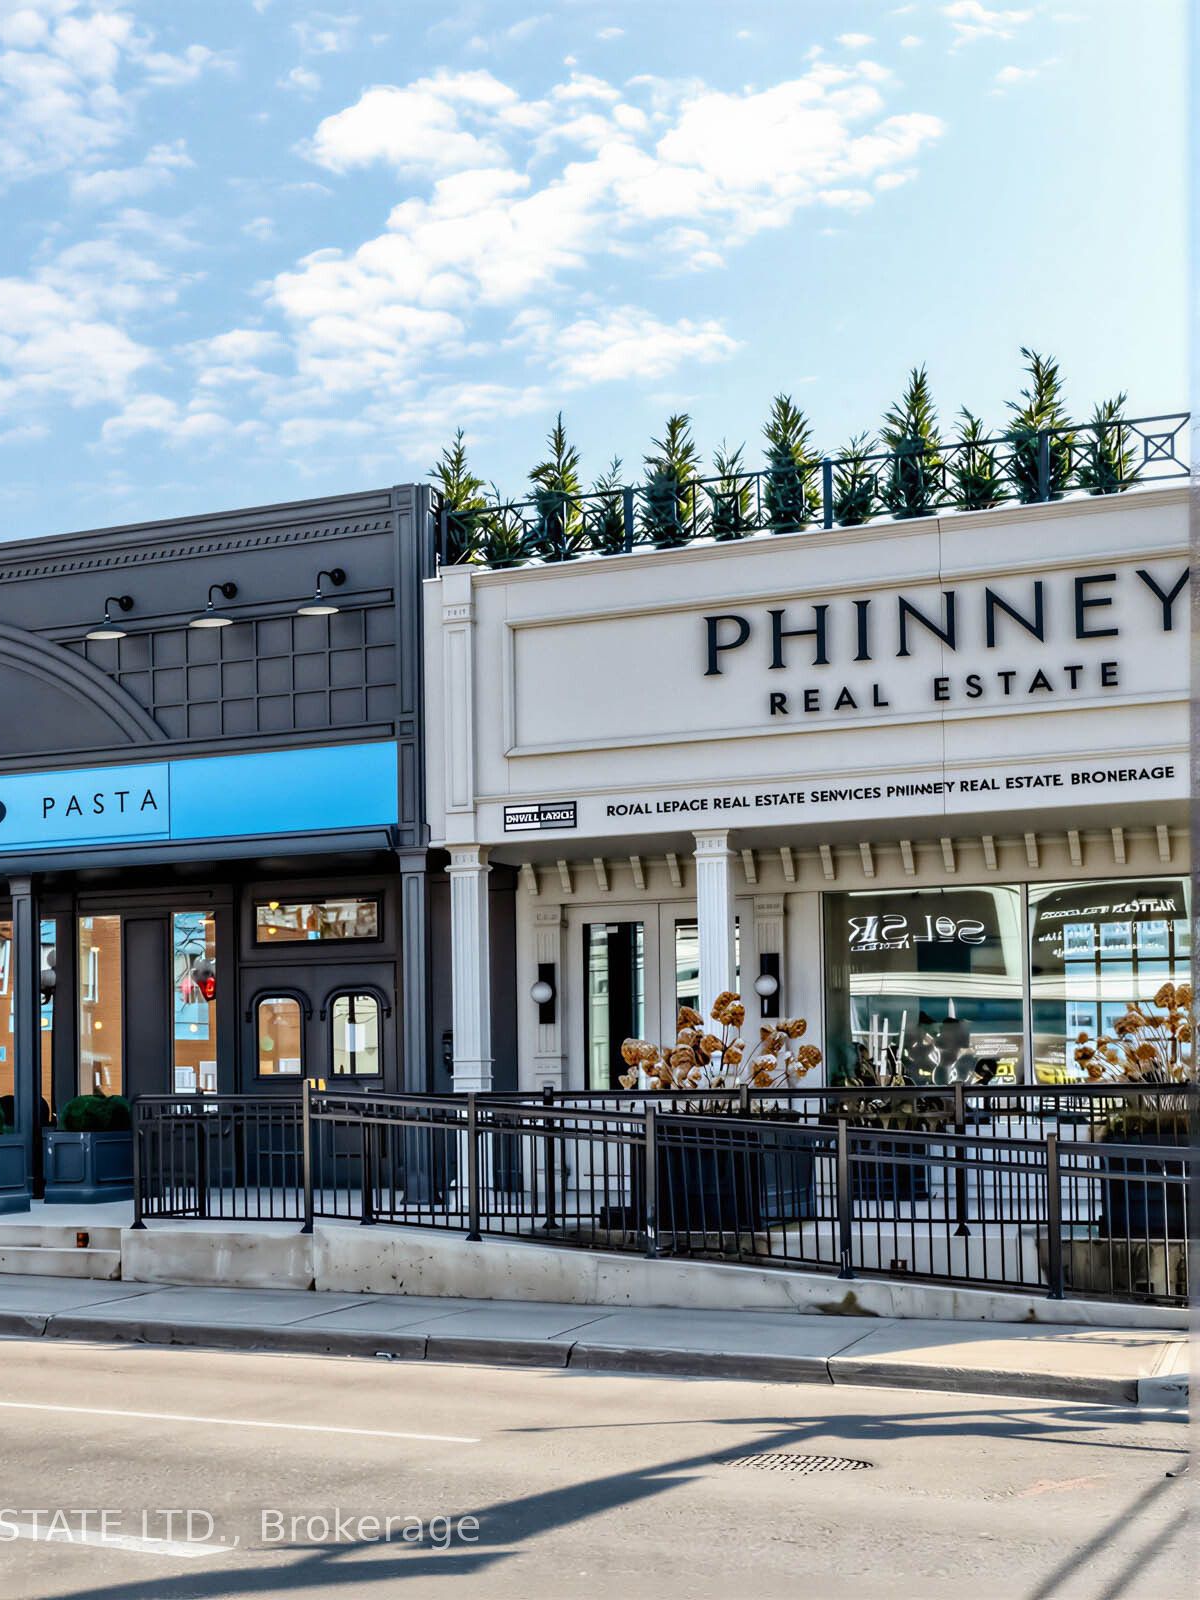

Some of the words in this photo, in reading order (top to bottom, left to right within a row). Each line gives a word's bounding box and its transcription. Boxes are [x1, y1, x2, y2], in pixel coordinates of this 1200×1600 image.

[703, 567, 1190, 676] PHINNEY
[769, 684, 889, 715] REAL
[933, 661, 1120, 701] ESTATE
[43, 789, 158, 819] PASTA
[713, 795, 750, 810] REAL
[755, 791, 805, 807] ESTATE
[959, 778, 1001, 793] REAL
[1005, 773, 1063, 790] ESTATE
